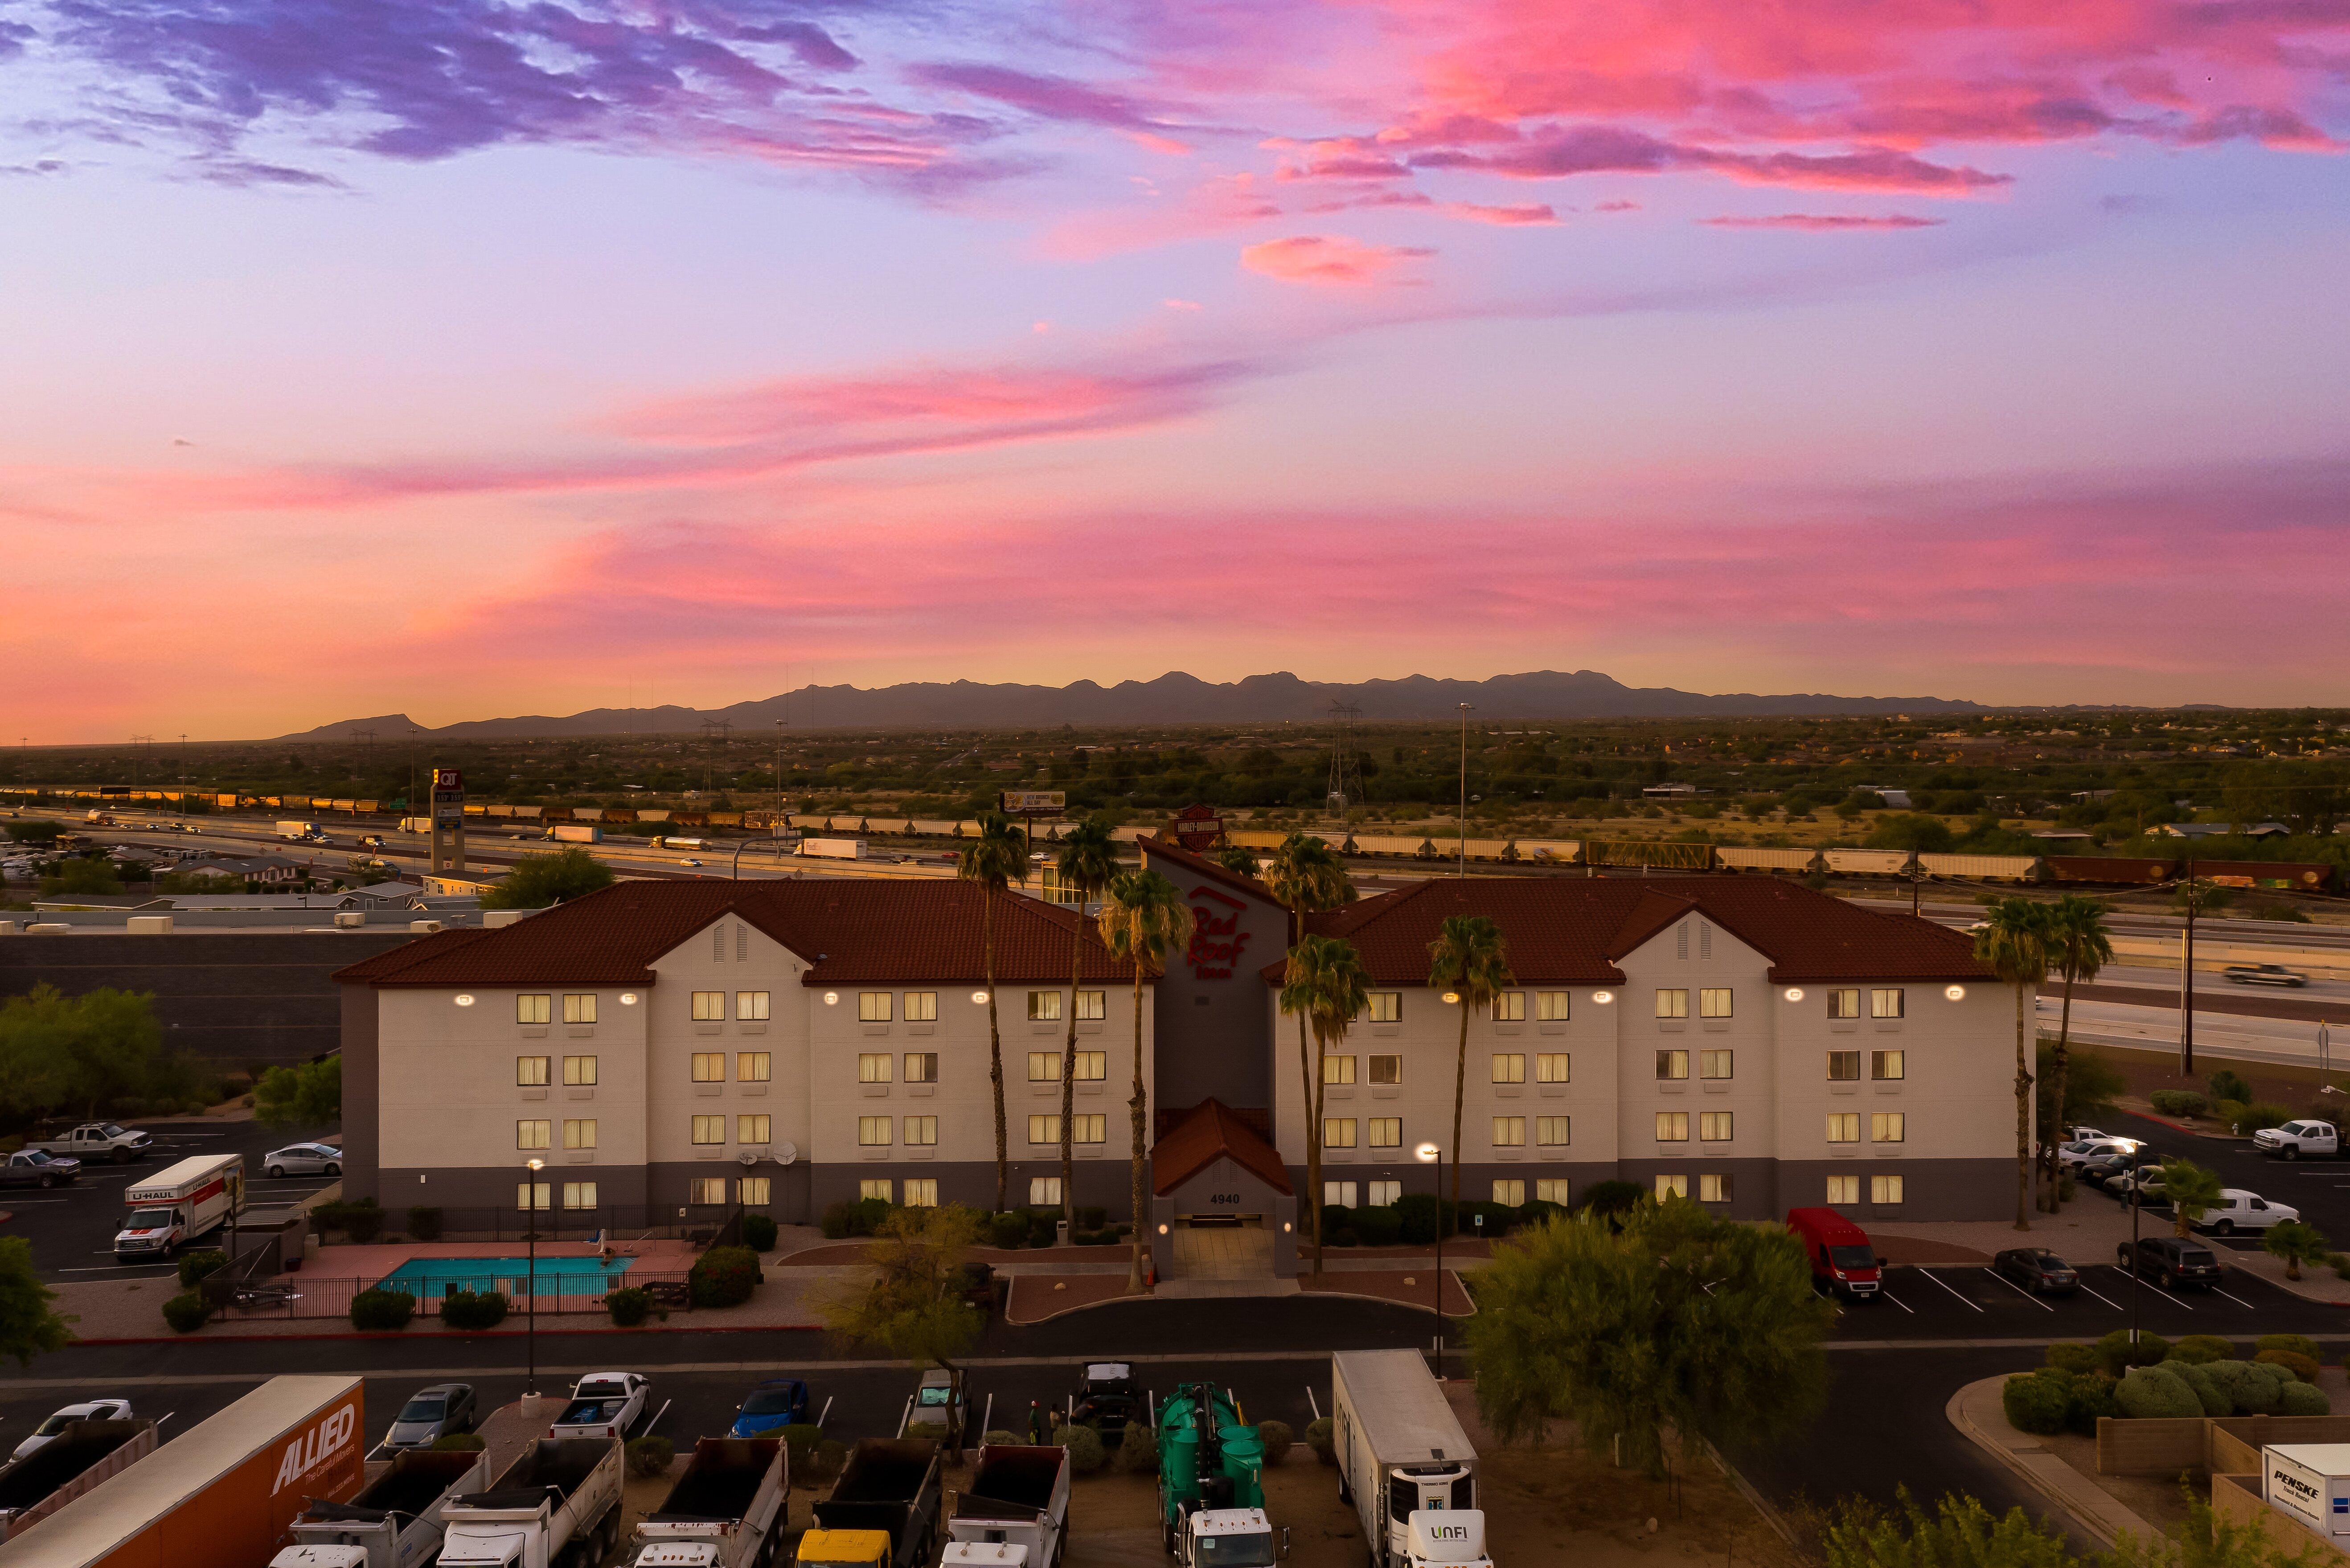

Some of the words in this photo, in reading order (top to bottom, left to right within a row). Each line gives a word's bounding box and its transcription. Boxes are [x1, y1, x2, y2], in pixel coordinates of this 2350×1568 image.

[440, 773, 457, 786] QT
[1178, 821, 1219, 832] HARLEY-DAVIDSON
[1193, 906, 1238, 936] Red
[1188, 934, 1250, 966] Roof
[1196, 966, 1231, 979] Inn
[1211, 1194, 1239, 1204] 4940
[270, 1404, 354, 1498] ALLIED
[305, 1472, 316, 1485] The
[316, 1454, 336, 1477] Careful
[336, 1444, 354, 1464] Movers
[2274, 1470, 2319, 1499] PENSKE
